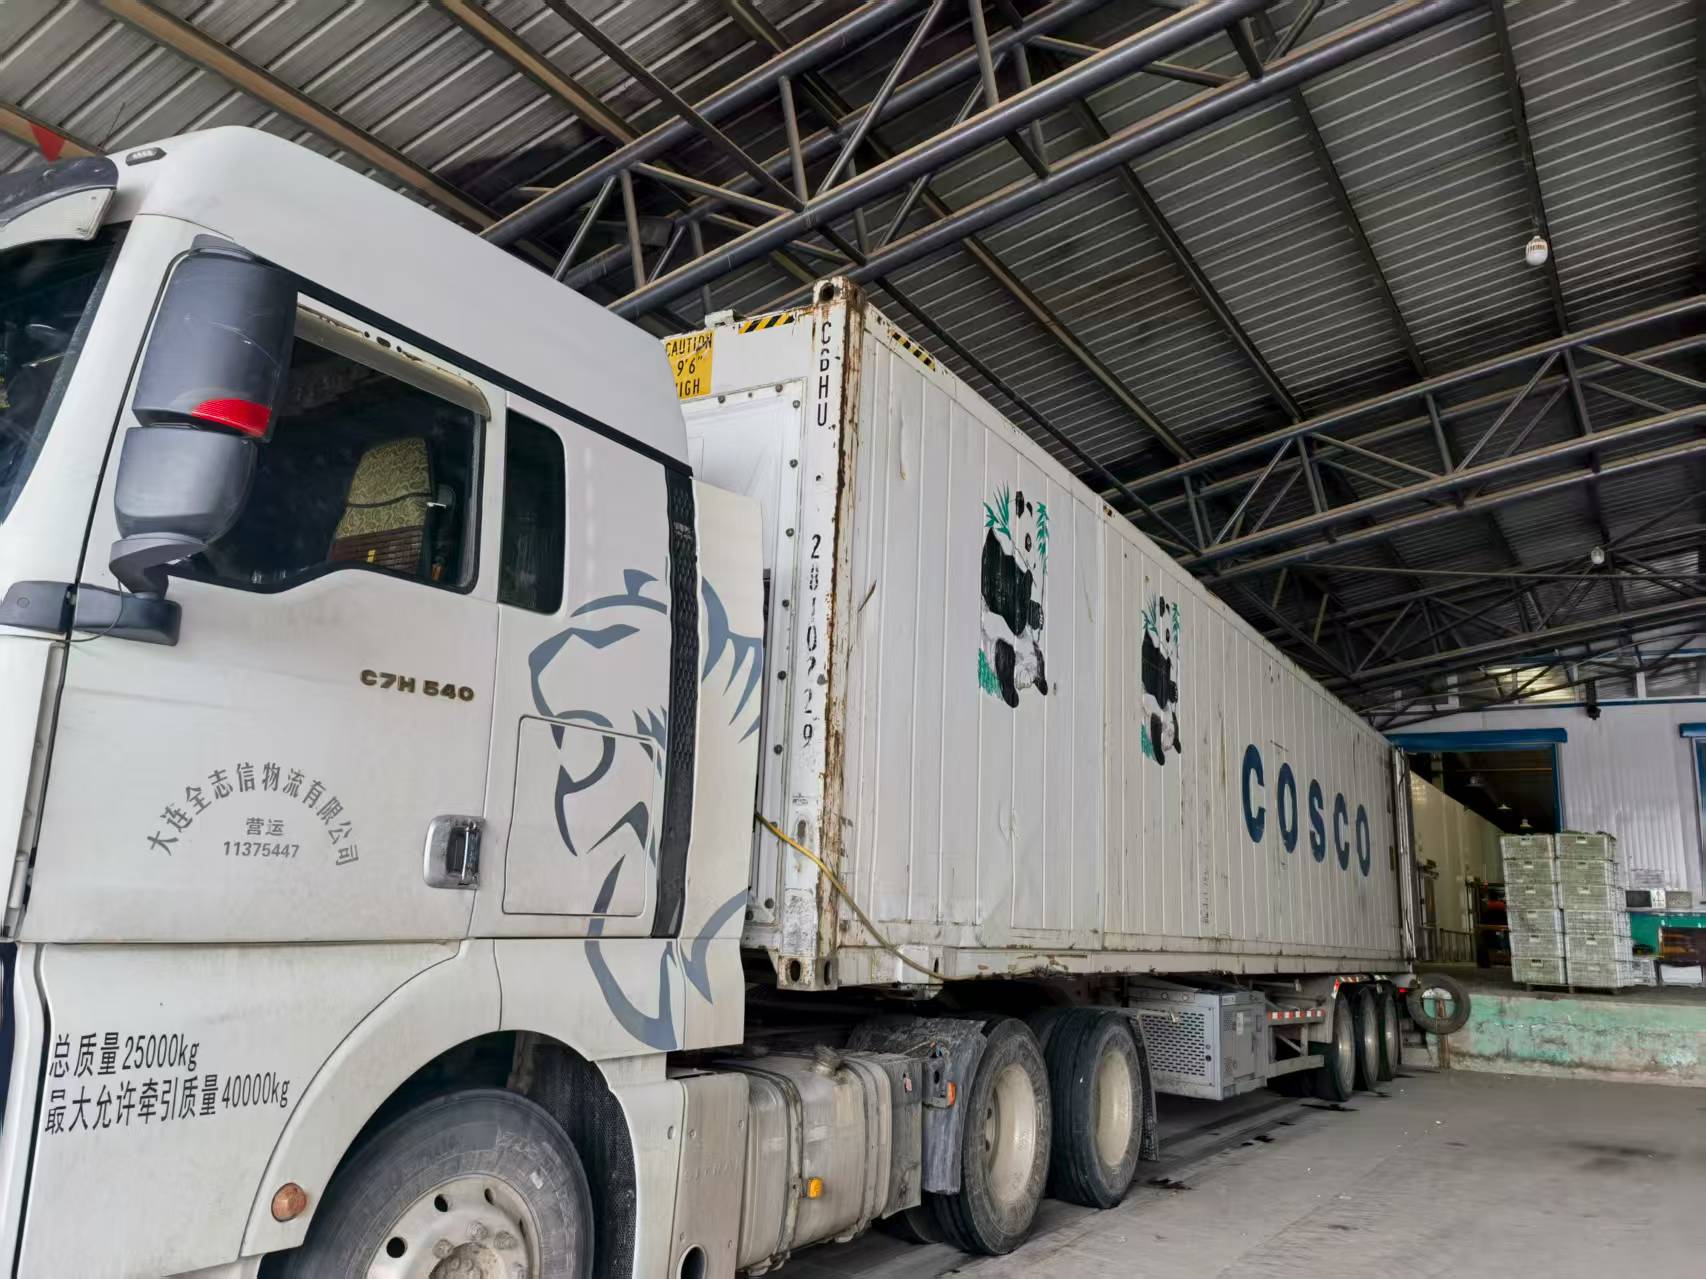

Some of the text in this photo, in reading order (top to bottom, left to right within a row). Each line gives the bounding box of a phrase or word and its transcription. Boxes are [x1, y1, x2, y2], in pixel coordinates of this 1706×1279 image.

[665, 332, 713, 358] CAUTION
[675, 378, 701, 398] IGH
[360, 669, 475, 702] C7H 540
[147, 761, 360, 867] 大连全志信物流有限公司
[1242, 744, 1371, 877] COSCO
[245, 817, 284, 837] 营运
[222, 840, 300, 859] 11375447
